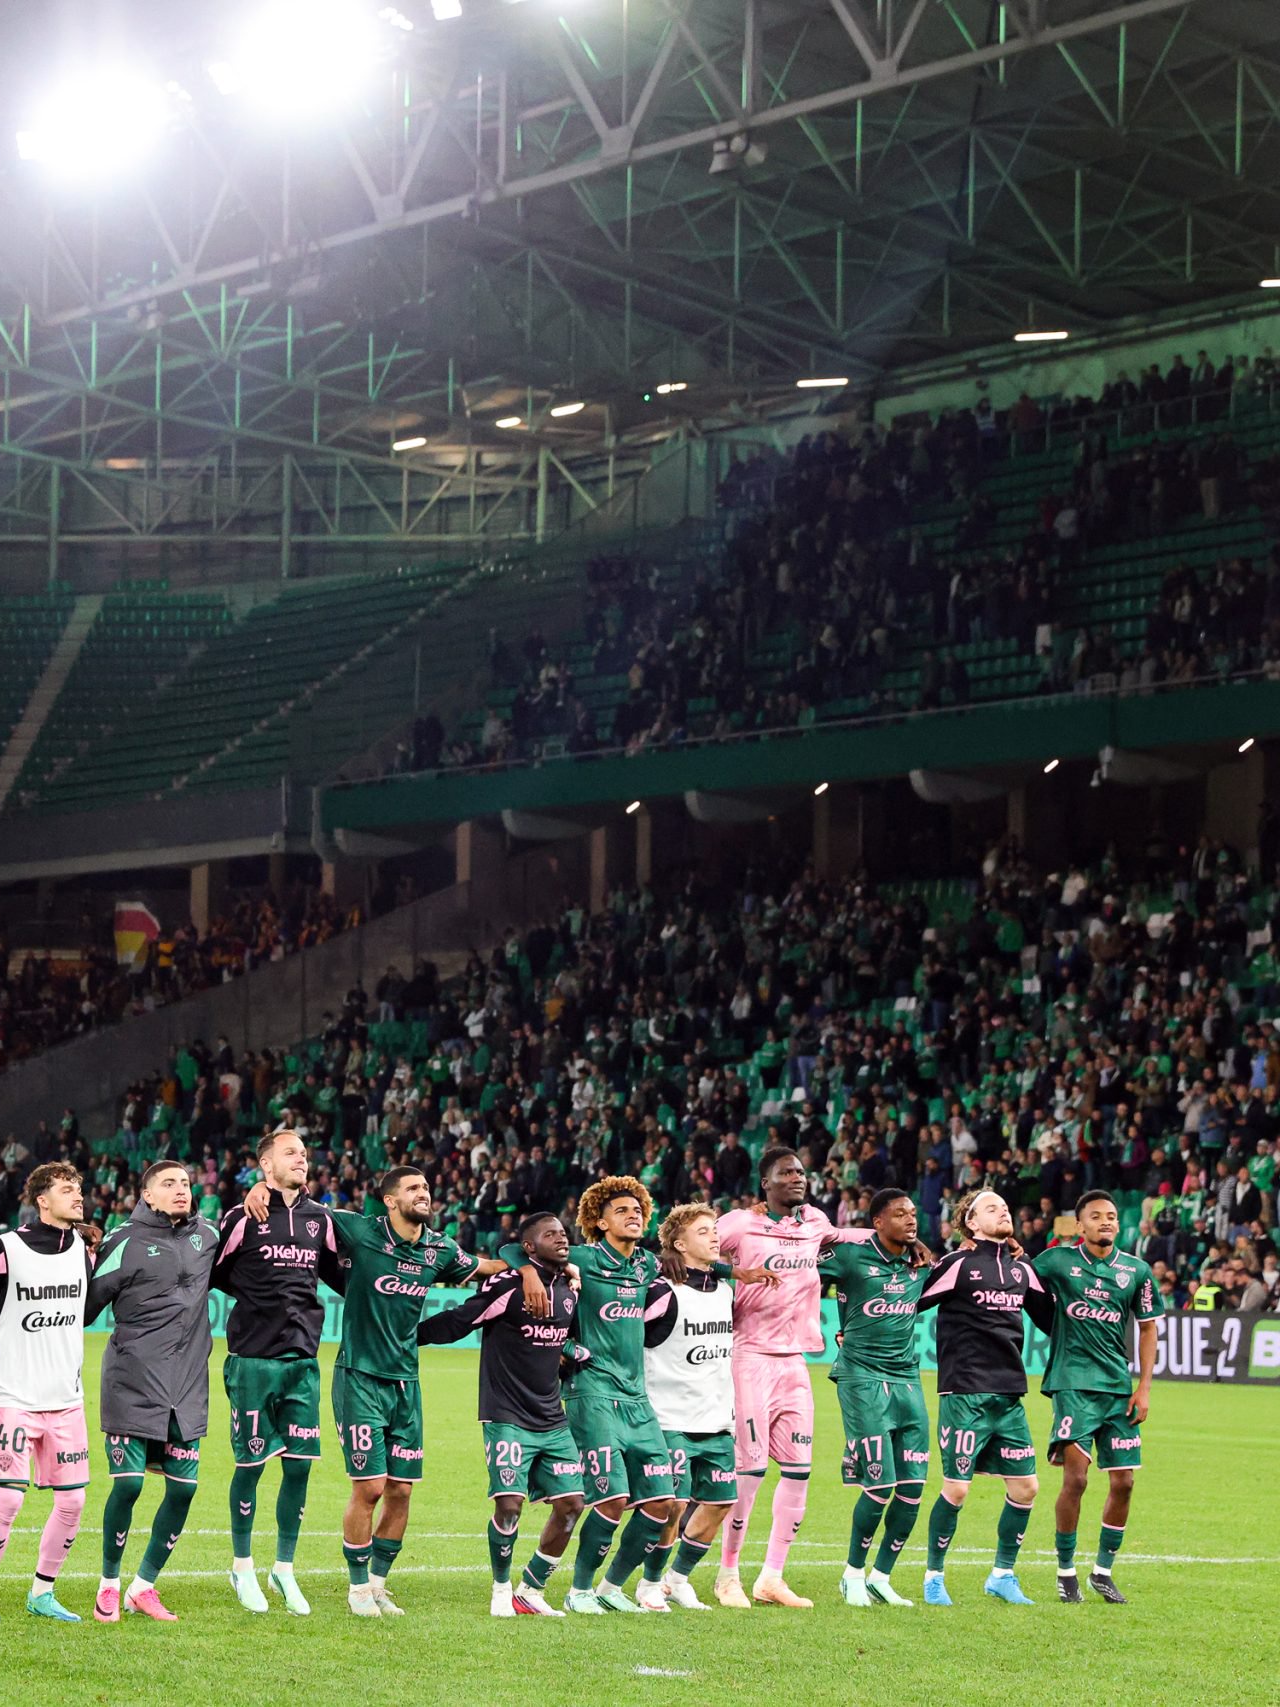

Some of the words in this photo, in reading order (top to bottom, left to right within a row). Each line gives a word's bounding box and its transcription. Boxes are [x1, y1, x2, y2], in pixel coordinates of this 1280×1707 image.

[272, 1244, 317, 1263] Kelyps
[764, 1253, 814, 1273] Casino
[397, 1261, 422, 1271] Loire
[16, 1278, 82, 1301] hummel
[883, 1283, 905, 1291] Loire
[985, 1290, 1024, 1307] Kelyps
[1084, 1287, 1110, 1299] Loire
[862, 1298, 916, 1318] Casino
[1066, 1300, 1122, 1323] Casino
[21, 1310, 76, 1332] Casino
[683, 1318, 733, 1336] humme
[1129, 1315, 1212, 1377] IGUE
[1216, 1317, 1242, 1378] 2
[246, 1409, 260, 1436] 7
[746, 1418, 757, 1442] 1
[1057, 1415, 1072, 1439] 8
[349, 1424, 373, 1451] 18
[861, 1435, 883, 1462] 17
[954, 1429, 976, 1455] 10
[495, 1440, 522, 1467] 20
[588, 1446, 612, 1476] 37
[669, 1449, 686, 1474] 2
